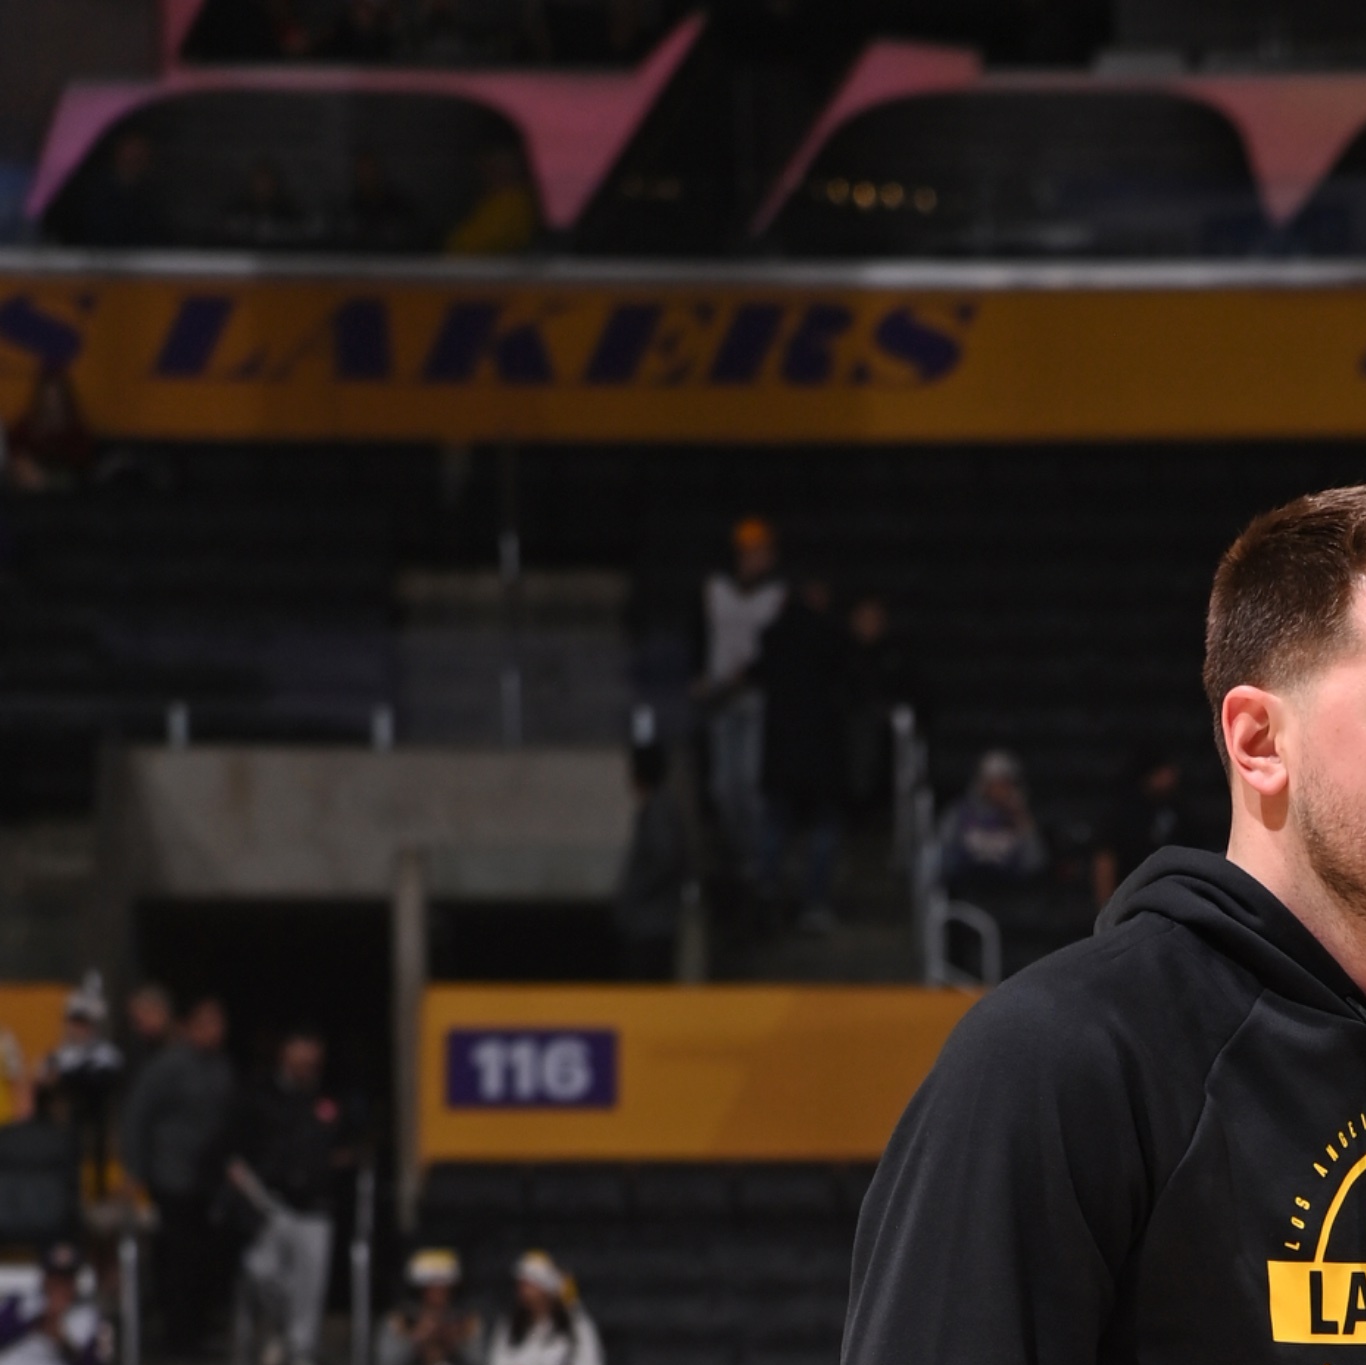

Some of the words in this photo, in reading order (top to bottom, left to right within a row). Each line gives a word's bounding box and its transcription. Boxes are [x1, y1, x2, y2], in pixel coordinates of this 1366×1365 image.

[150, 296, 981, 388] LAKERS
[471, 1037, 593, 1099] 116
[1284, 1196, 1310, 1251] LOS
